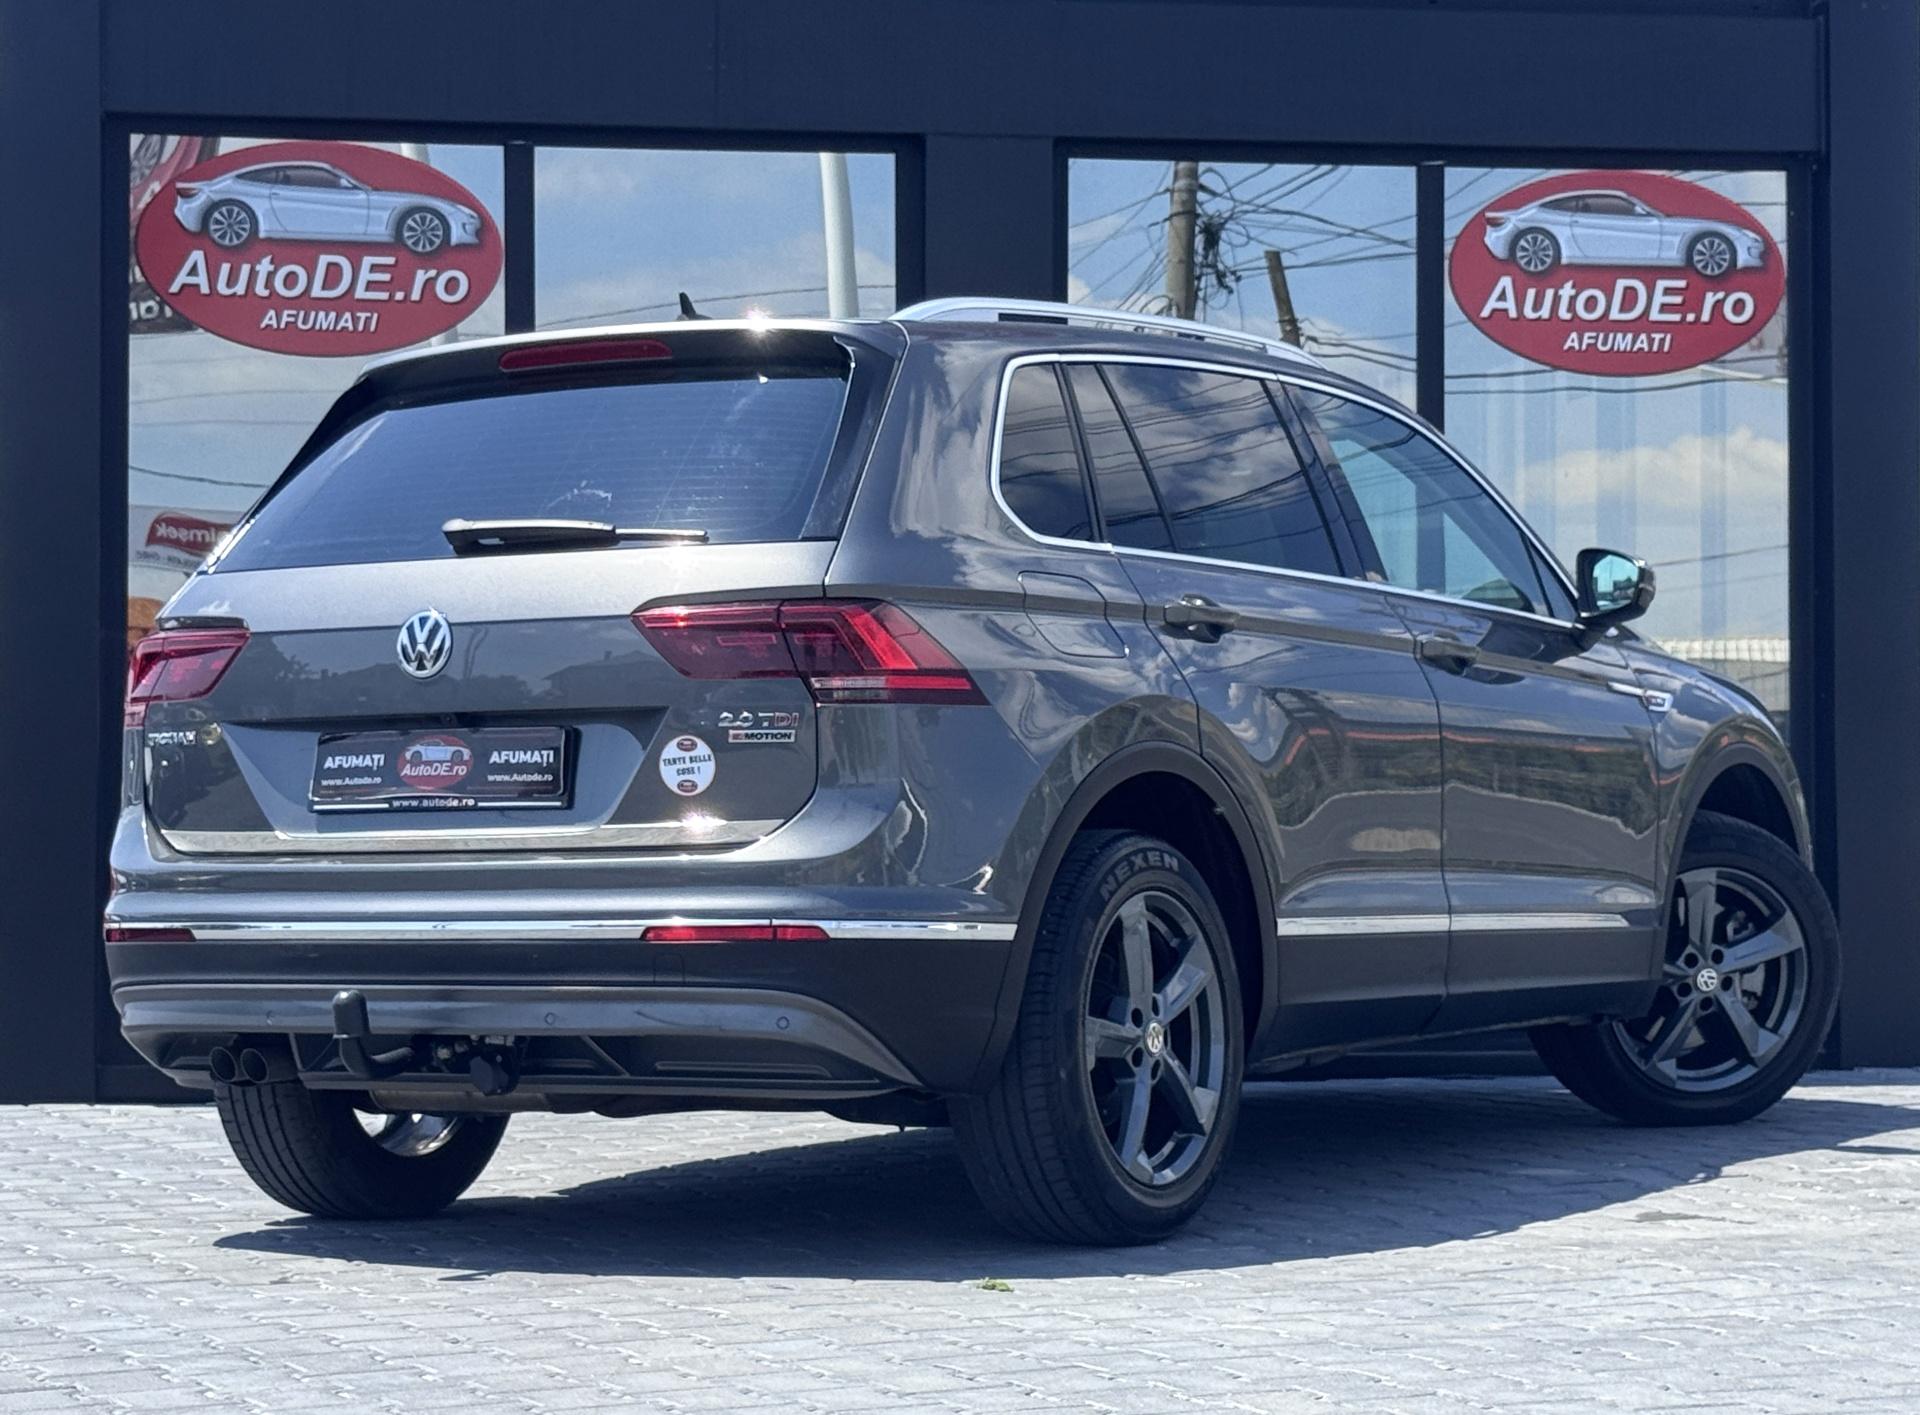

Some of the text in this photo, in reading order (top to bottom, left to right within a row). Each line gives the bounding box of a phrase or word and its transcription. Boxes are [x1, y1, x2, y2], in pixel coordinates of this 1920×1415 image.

[168, 249, 471, 304] AutoDE.ro
[1479, 275, 1756, 325] AutoDE.ro
[260, 309, 379, 333] AFUMATI
[1562, 331, 1672, 353] AFUMATI
[758, 711, 800, 727] TDI
[400, 763, 468, 777] AutoDE.ro
[392, 797, 475, 808] www.autode.ro
[1100, 850, 1180, 901] NEXEN
